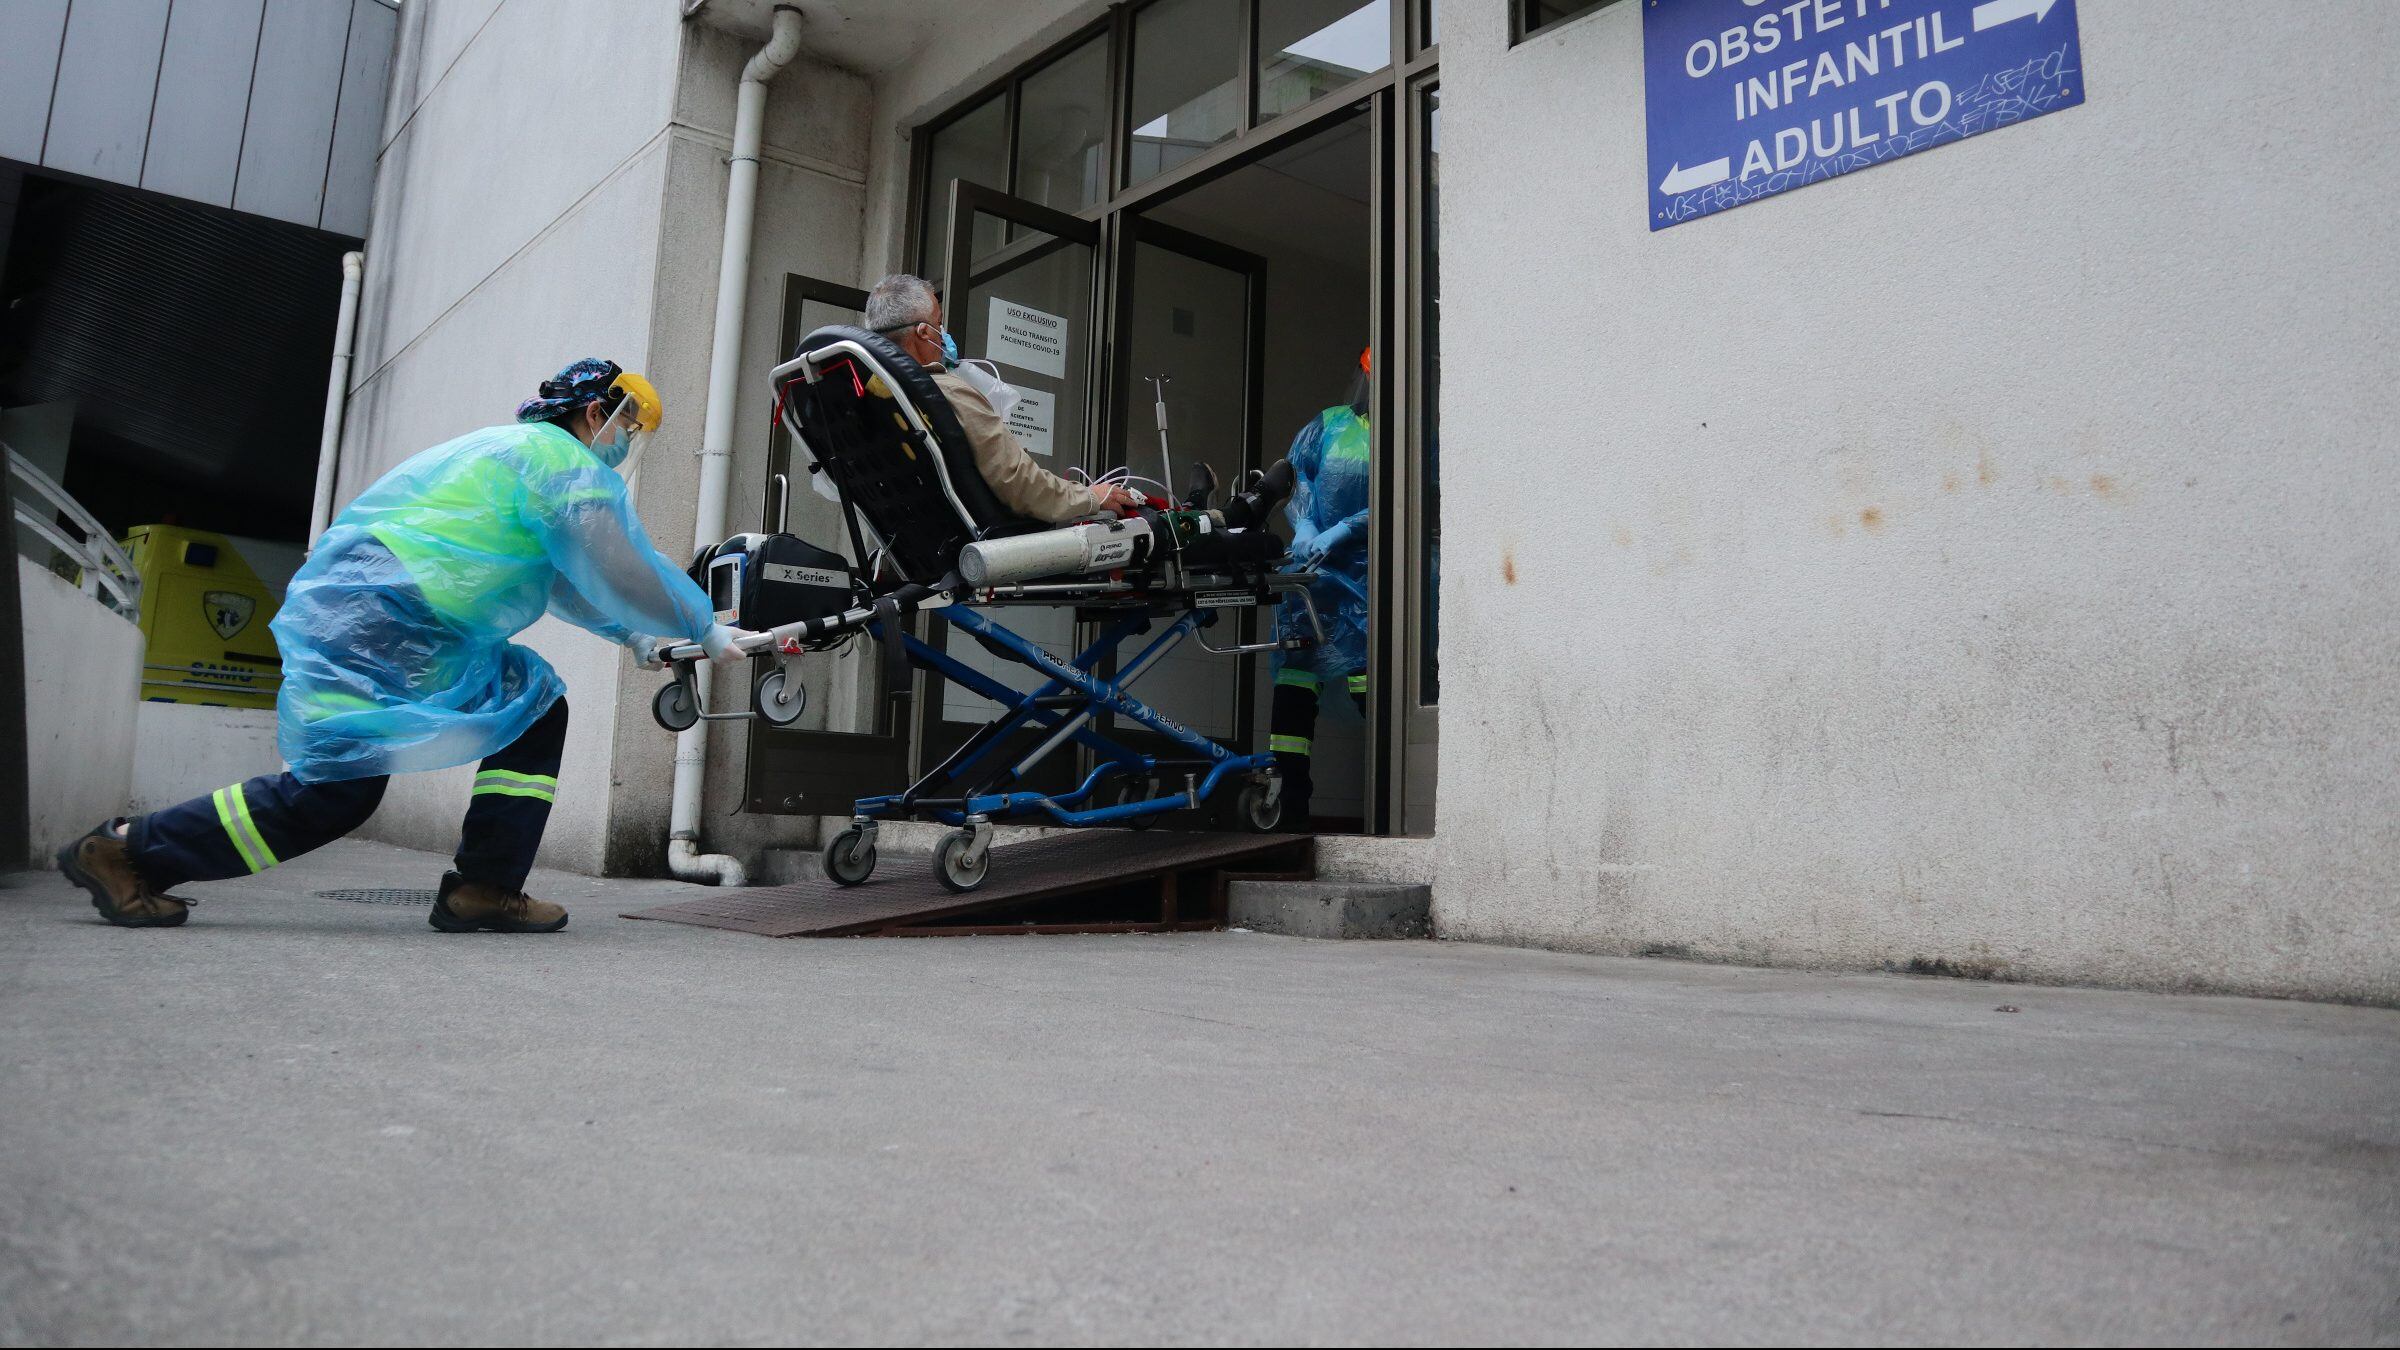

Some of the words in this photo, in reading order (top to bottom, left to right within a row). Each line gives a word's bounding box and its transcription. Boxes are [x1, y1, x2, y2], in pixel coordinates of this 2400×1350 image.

[1685, 0, 1891, 78] OBSTE
[1734, 11, 1965, 120] INFANTIL
[1740, 80, 1951, 183] ADULTO
[1007, 307, 1022, 317] USO
[1022, 311, 1058, 328] EXCLUSIVO
[1000, 334, 1032, 349] PACIENTES
[1032, 343, 1060, 356] COVID-19
[1004, 324, 1028, 337] PASILLO
[1029, 331, 1058, 345] TRANSITO
[1020, 398, 1039, 407] NGRESO
[1009, 421, 1048, 433] RESPIRATORIOS
[1010, 413, 1034, 421] ACIENTES
[784, 570, 793, 579] X
[1153, 710, 1185, 734] FERNO
